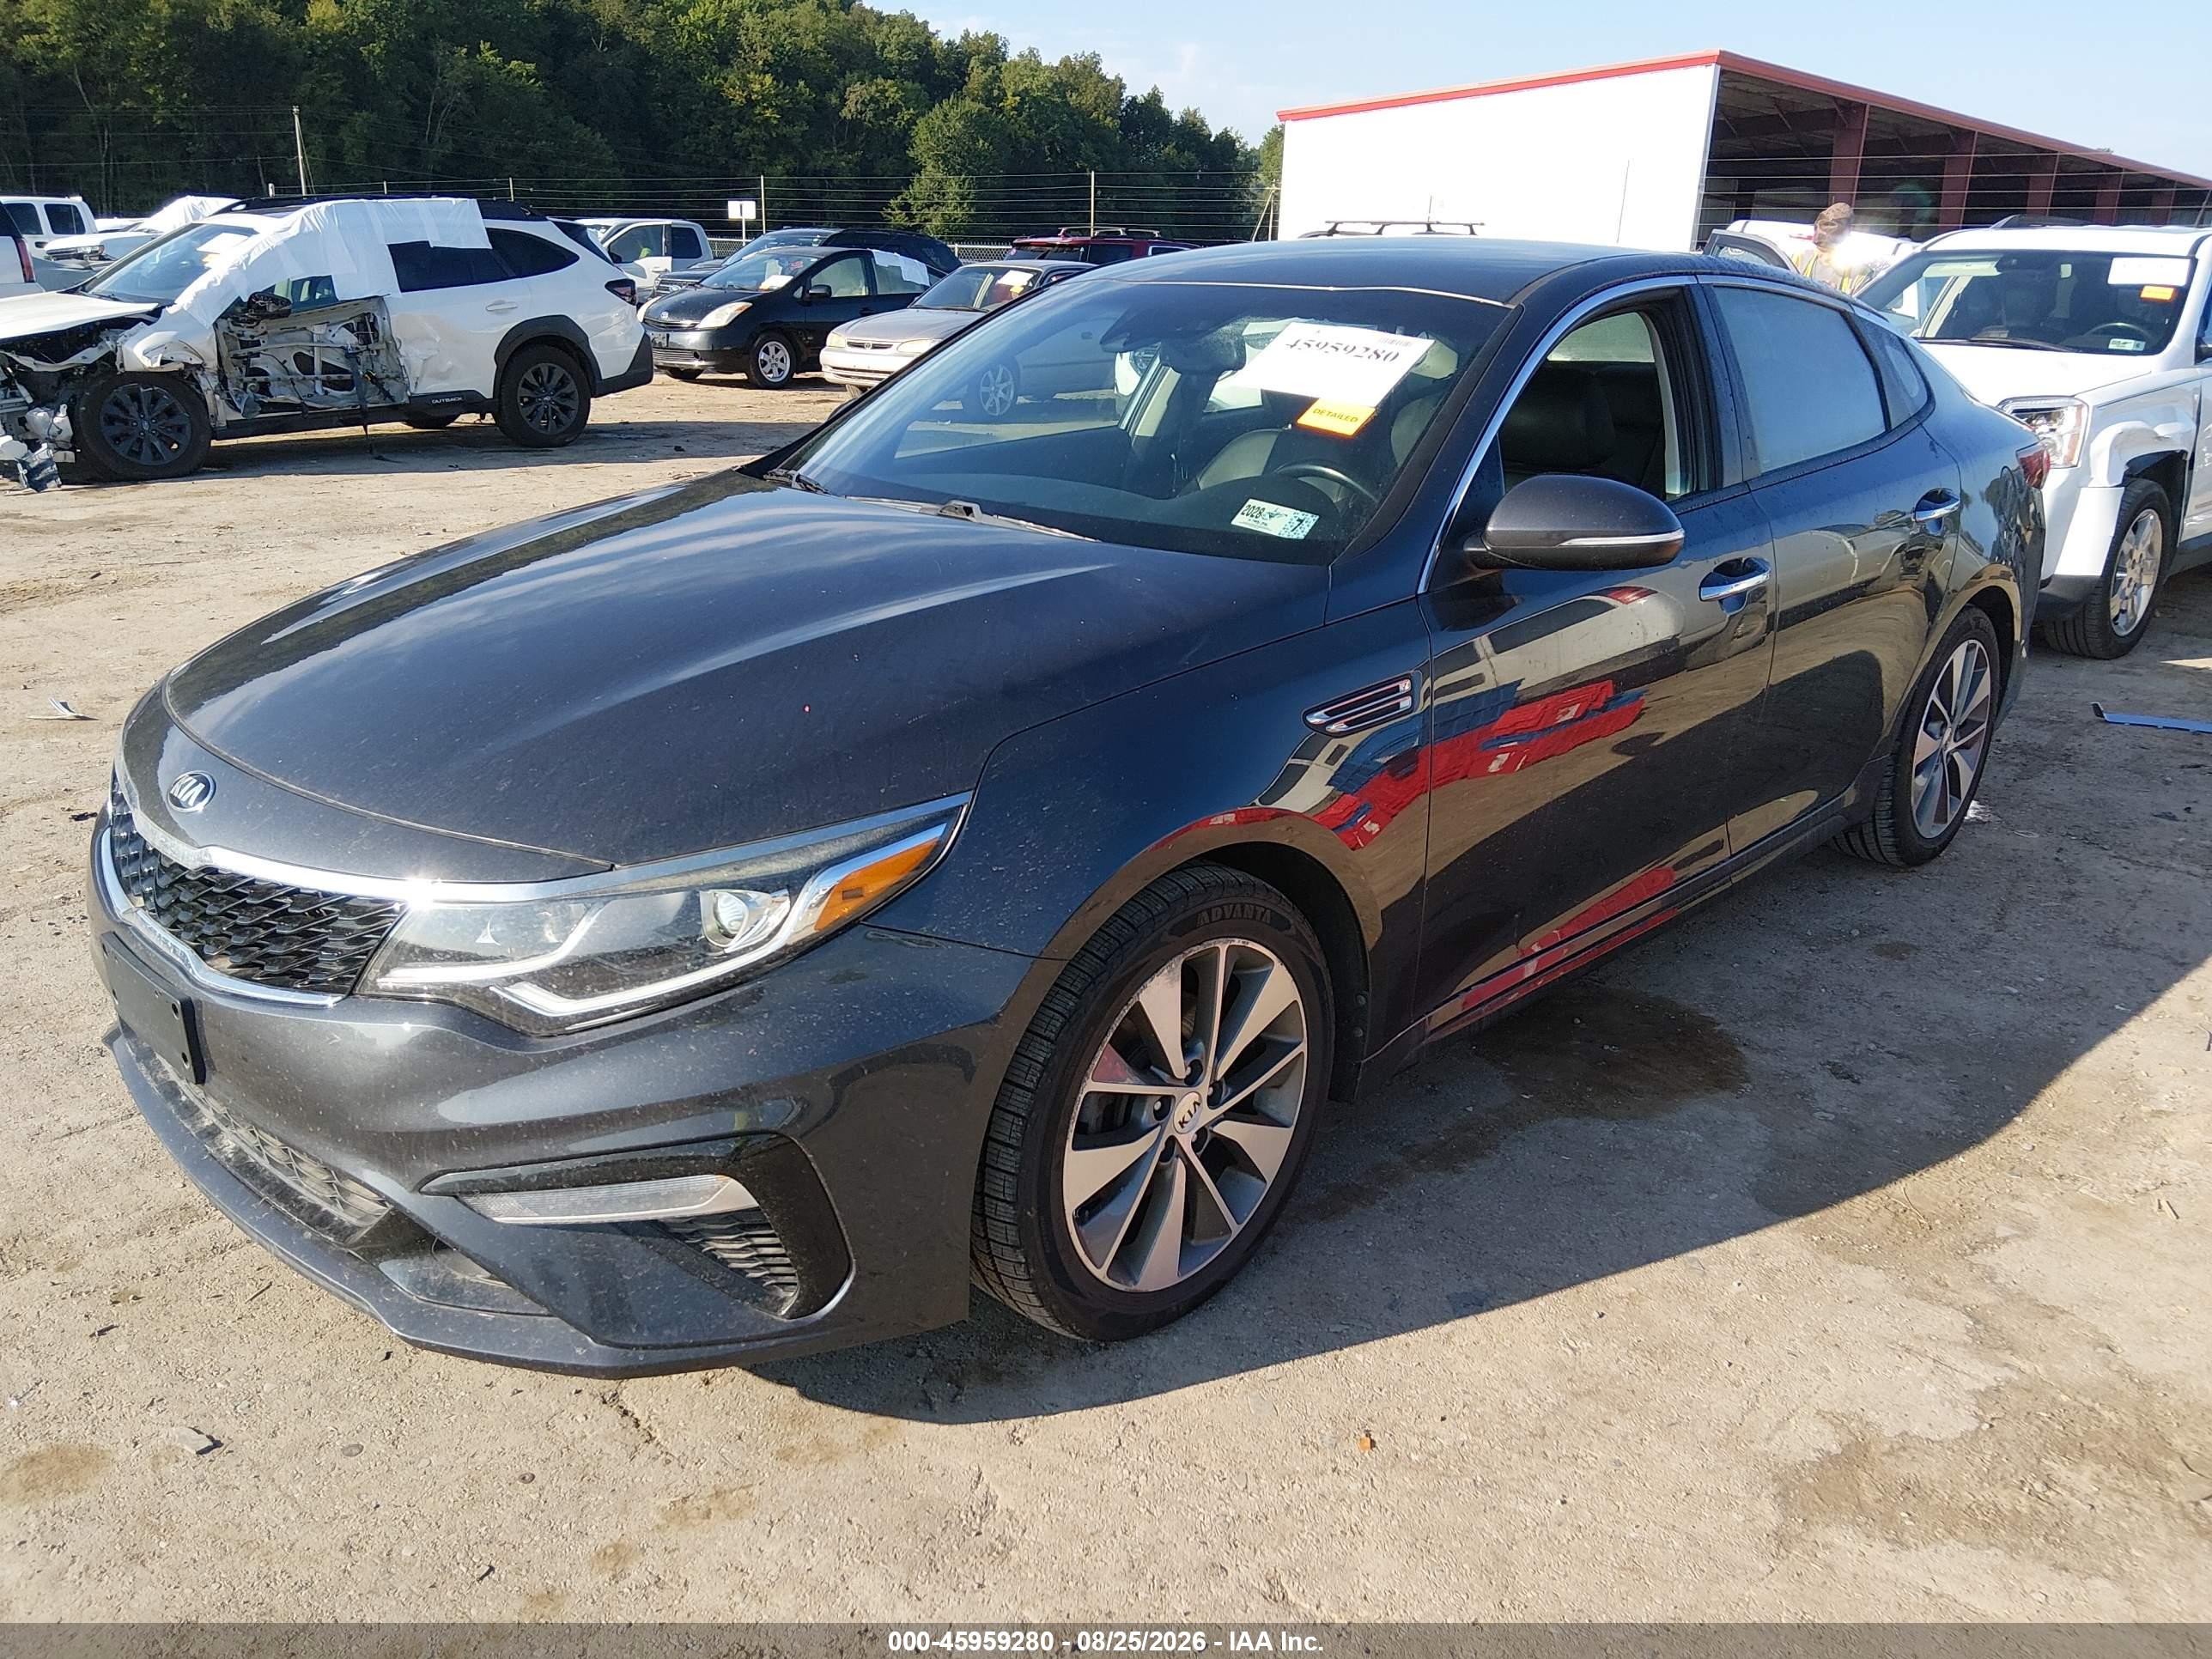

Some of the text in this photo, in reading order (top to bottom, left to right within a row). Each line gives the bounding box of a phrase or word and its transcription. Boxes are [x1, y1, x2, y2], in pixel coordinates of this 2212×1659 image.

[1286, 338, 1400, 362] 45959280
[1312, 407, 1358, 422] DETAILED
[169, 775, 206, 807] KIA
[1196, 902, 1271, 927] ADVANTA
[1178, 1100, 1201, 1130] KIA
